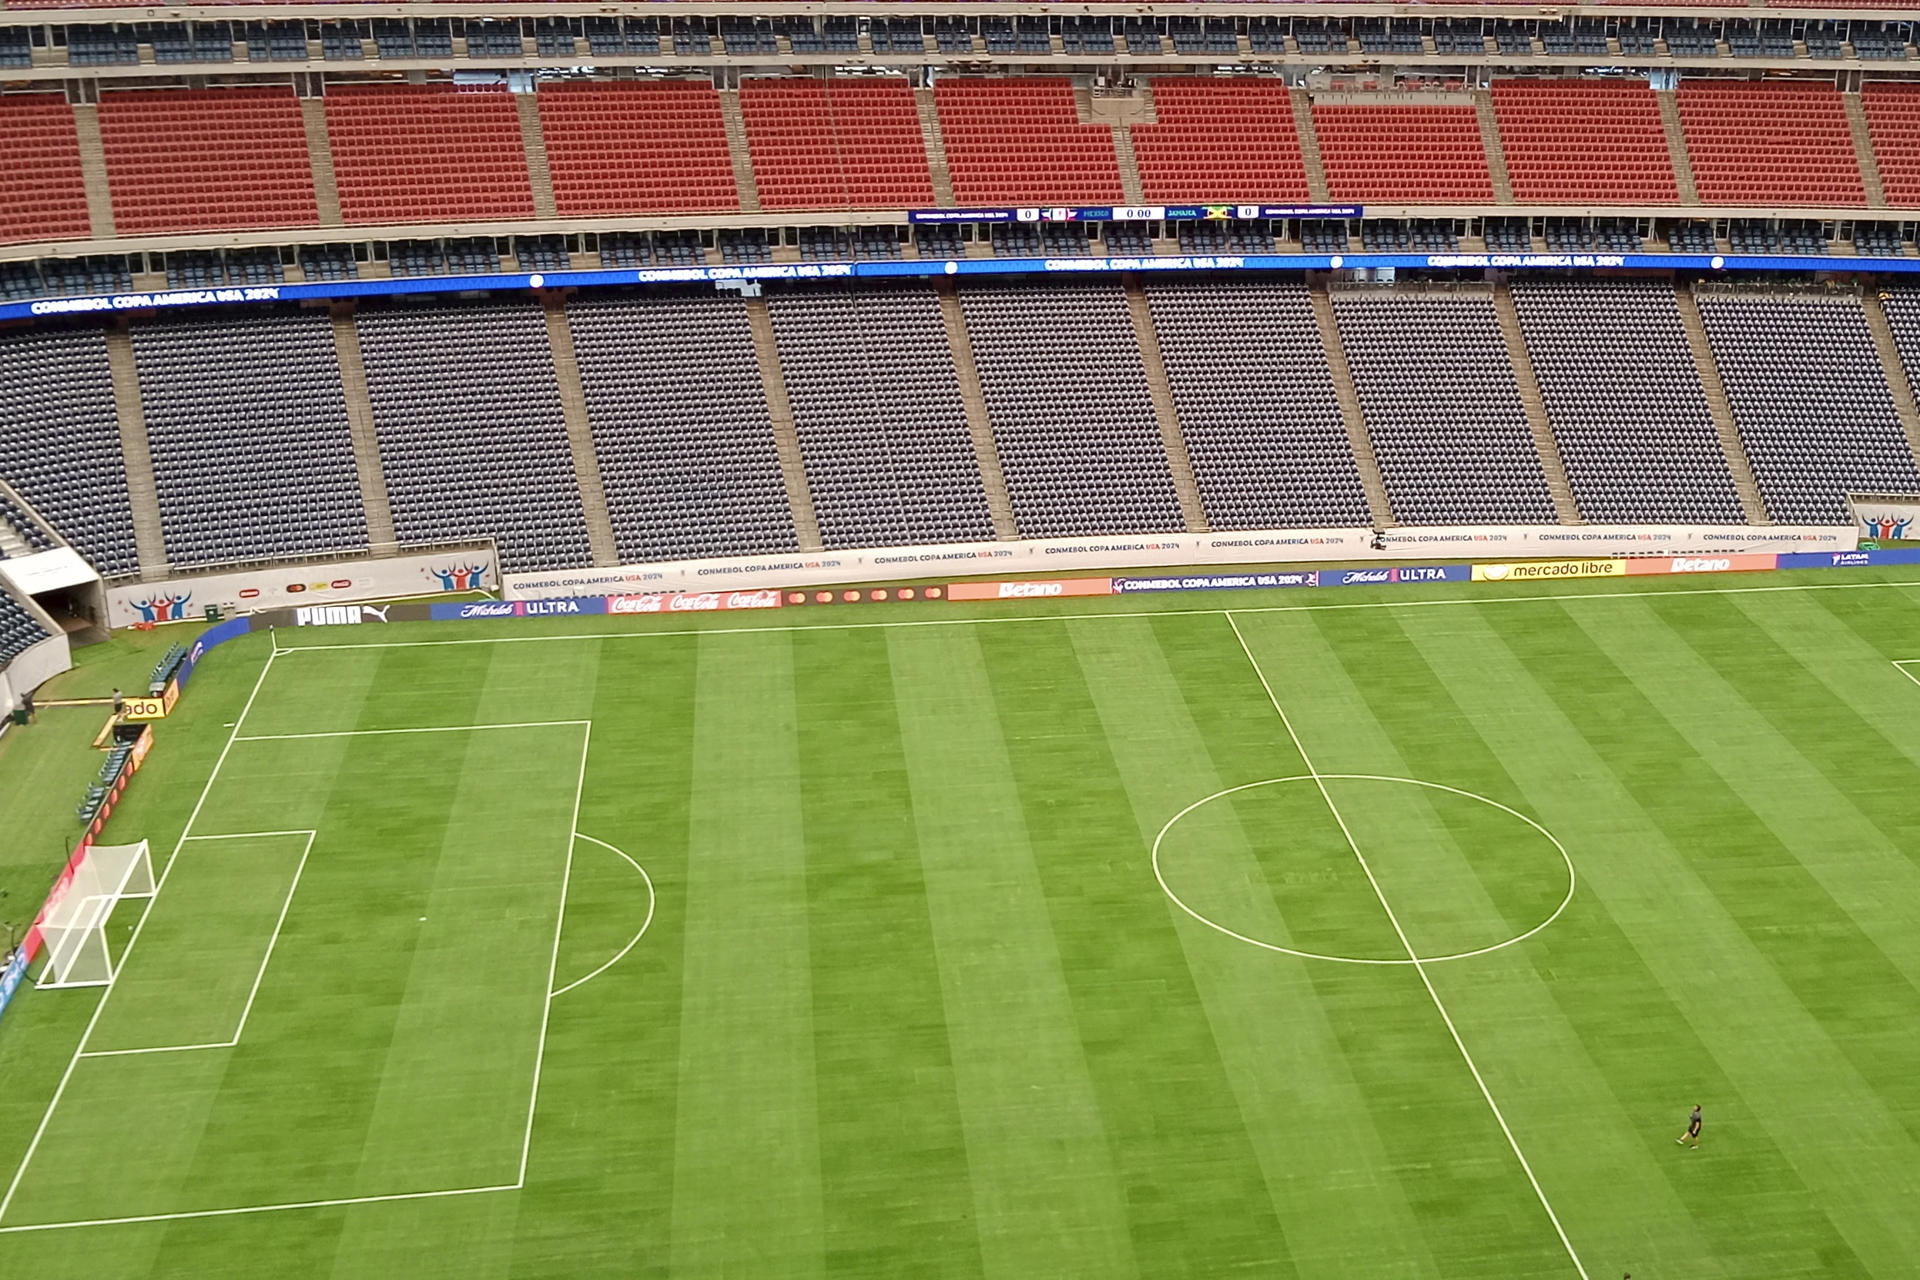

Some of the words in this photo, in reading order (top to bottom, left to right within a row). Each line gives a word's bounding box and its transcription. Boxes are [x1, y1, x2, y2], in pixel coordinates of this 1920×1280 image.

[1025, 210, 1031, 219] 0
[1168, 209, 1196, 217] JAMAICA
[1245, 207, 1251, 216] 0
[1211, 540, 1254, 548] CONMEBOL
[1254, 539, 1275, 547] COPA
[1439, 534, 1473, 542] AMERICA
[1702, 533, 1745, 541] CONMEBOL
[1045, 545, 1088, 554] CONMEBOL
[1089, 544, 1111, 552] COPA
[1111, 543, 1145, 552] AMERICA
[874, 555, 918, 564] CONMEBOL
[919, 553, 941, 562] COPA
[941, 552, 977, 560] AMERICA
[1670, 557, 1730, 572] Betano
[697, 566, 743, 576] CONMEBOL
[744, 564, 767, 573] COPA
[767, 562, 804, 571] AMERICA
[1514, 563, 1579, 577] mercado
[1581, 561, 1613, 574] libre
[513, 580, 561, 590] CONMEBOL
[562, 578, 585, 587] COPA
[585, 575, 625, 585] AMERICA
[625, 573, 642, 582] USA
[642, 573, 663, 581] 2024
[1124, 579, 1181, 590] CONMEBOL
[1182, 578, 1211, 588] COPA
[1210, 576, 1257, 587] AMERICA
[1258, 575, 1277, 586] USA
[1278, 574, 1305, 584] 2024
[1342, 570, 1390, 585] Michelob
[1400, 568, 1447, 581] ULTRA
[998, 581, 1063, 598] Betano
[461, 600, 515, 618] Michelob
[526, 600, 580, 614] ULTRA
[296, 606, 362, 627] PUMA
